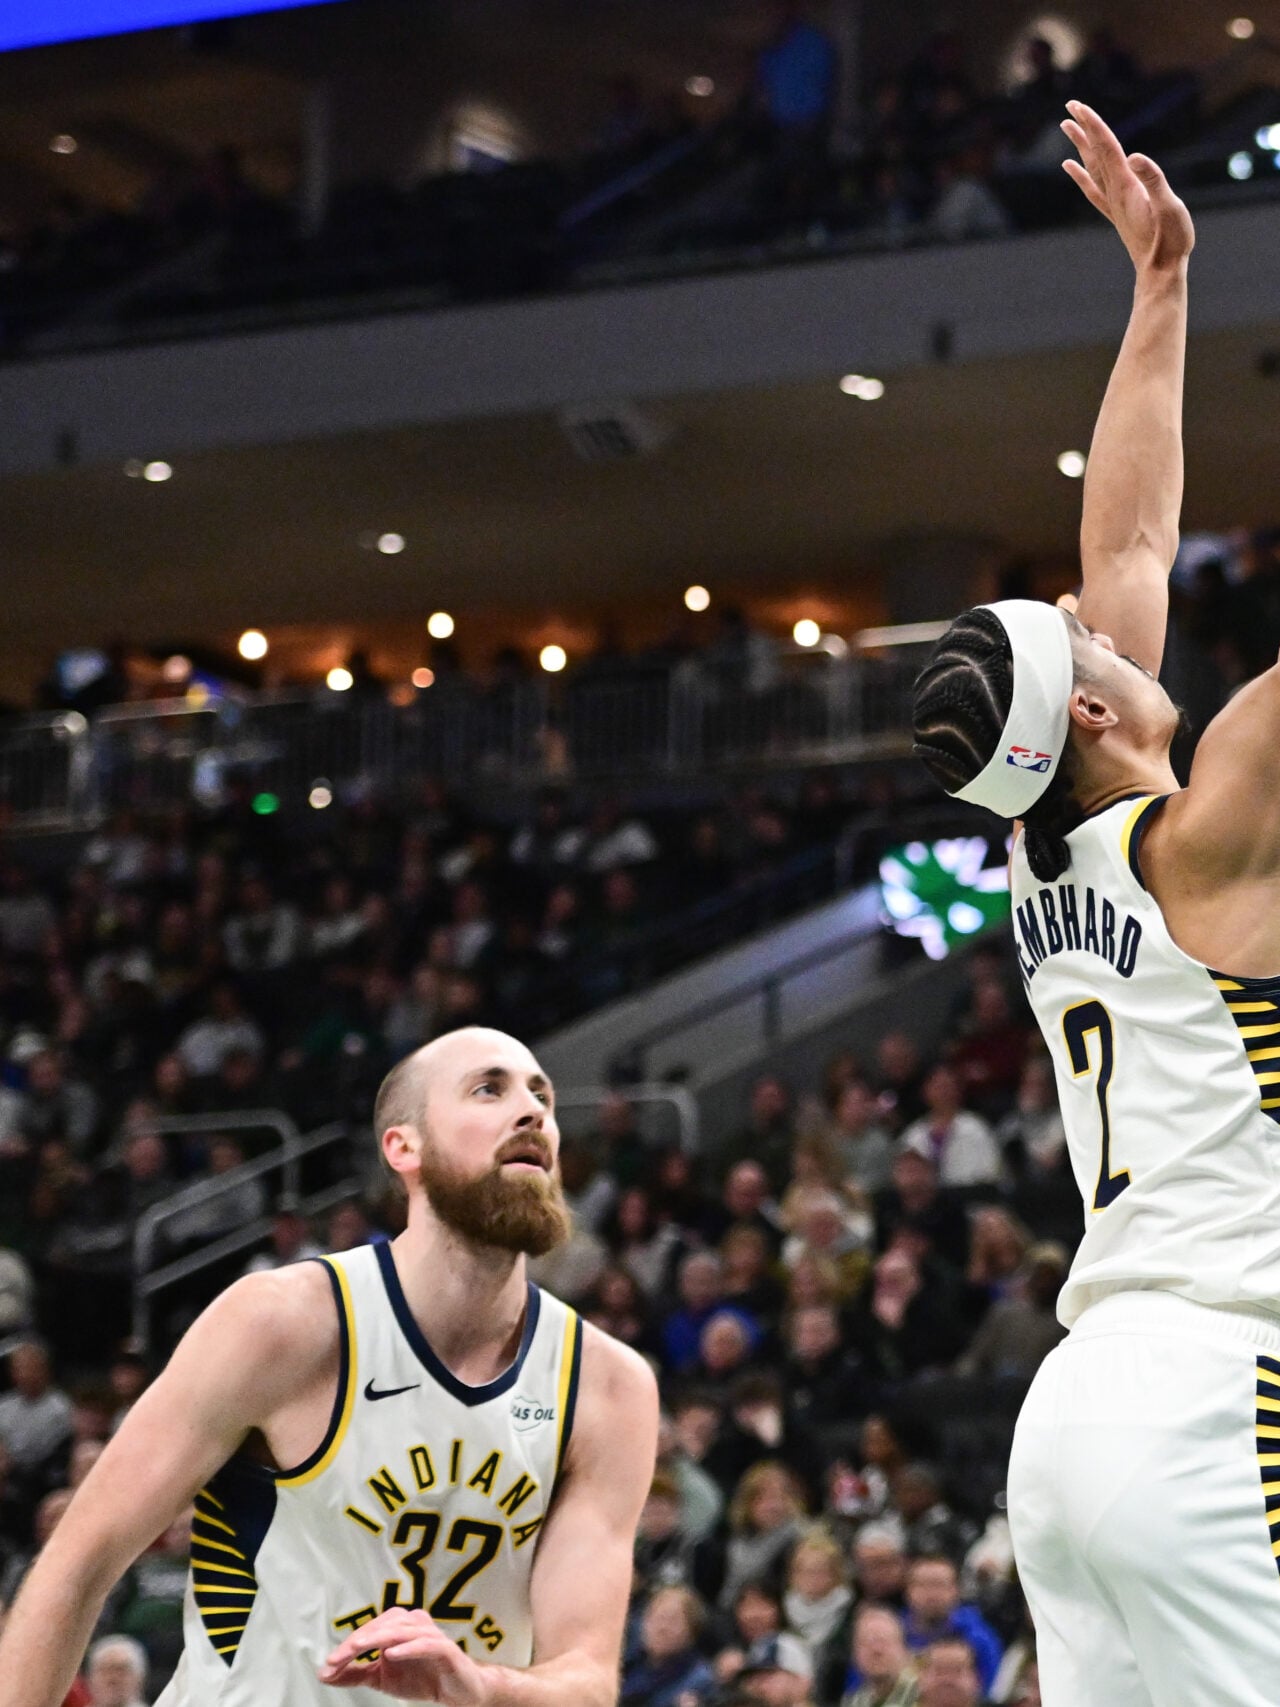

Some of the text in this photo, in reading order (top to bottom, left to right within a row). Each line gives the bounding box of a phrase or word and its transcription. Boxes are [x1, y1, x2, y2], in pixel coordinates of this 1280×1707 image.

[1017, 884, 1142, 988] EMBHARD
[1061, 997, 1133, 1214] 2
[534, 1408, 554, 1420] OIL
[344, 1438, 545, 1550] INDIANA
[382, 1509, 503, 1622] 32
